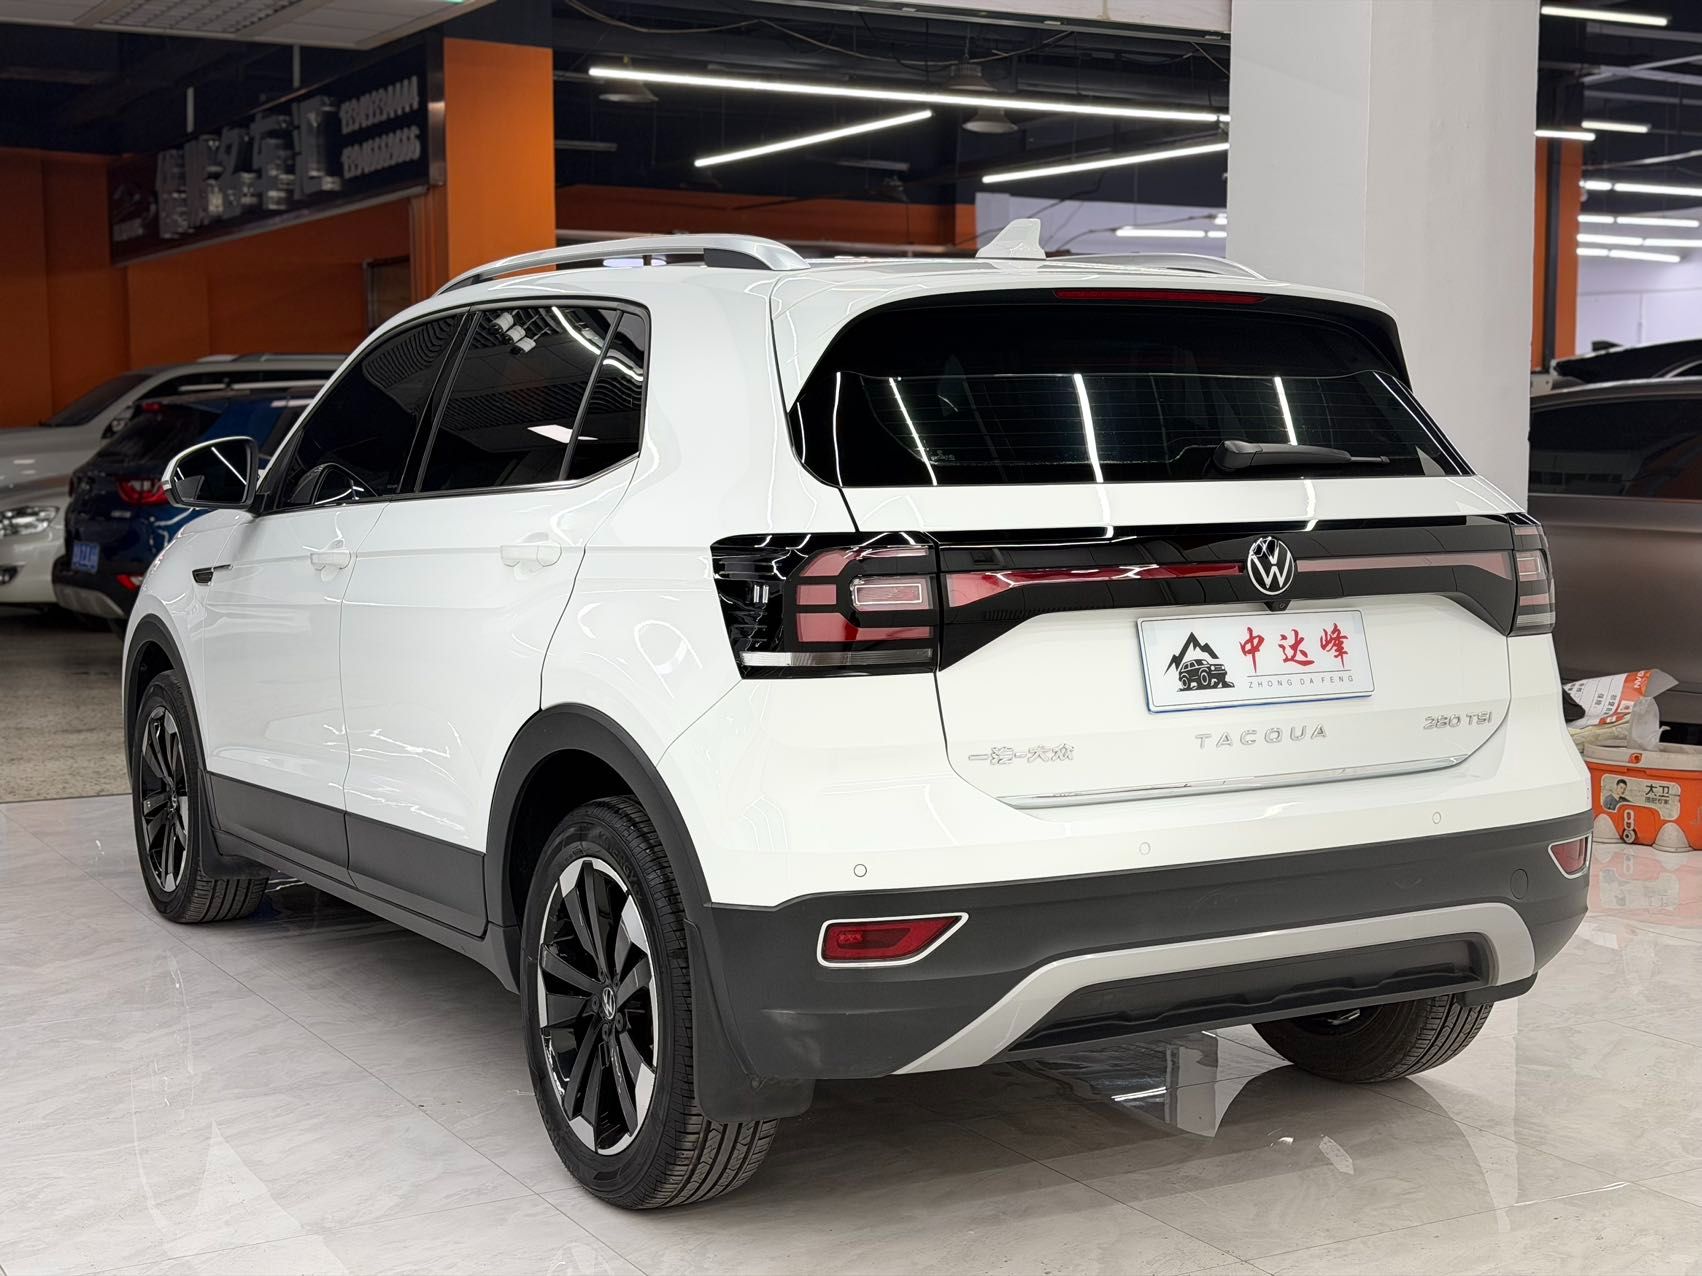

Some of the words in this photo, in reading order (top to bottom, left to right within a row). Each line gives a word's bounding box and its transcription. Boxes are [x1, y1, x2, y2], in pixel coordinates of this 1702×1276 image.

[1239, 623, 1350, 674] 中达峰
[1248, 679, 1293, 689] ZHONG
[1321, 675, 1354, 683] FENG
[1423, 714, 1461, 730] 280
[1466, 711, 1492, 725] TSI
[1195, 723, 1327, 749] TACQUA
[1645, 784, 1669, 798] 大卫
